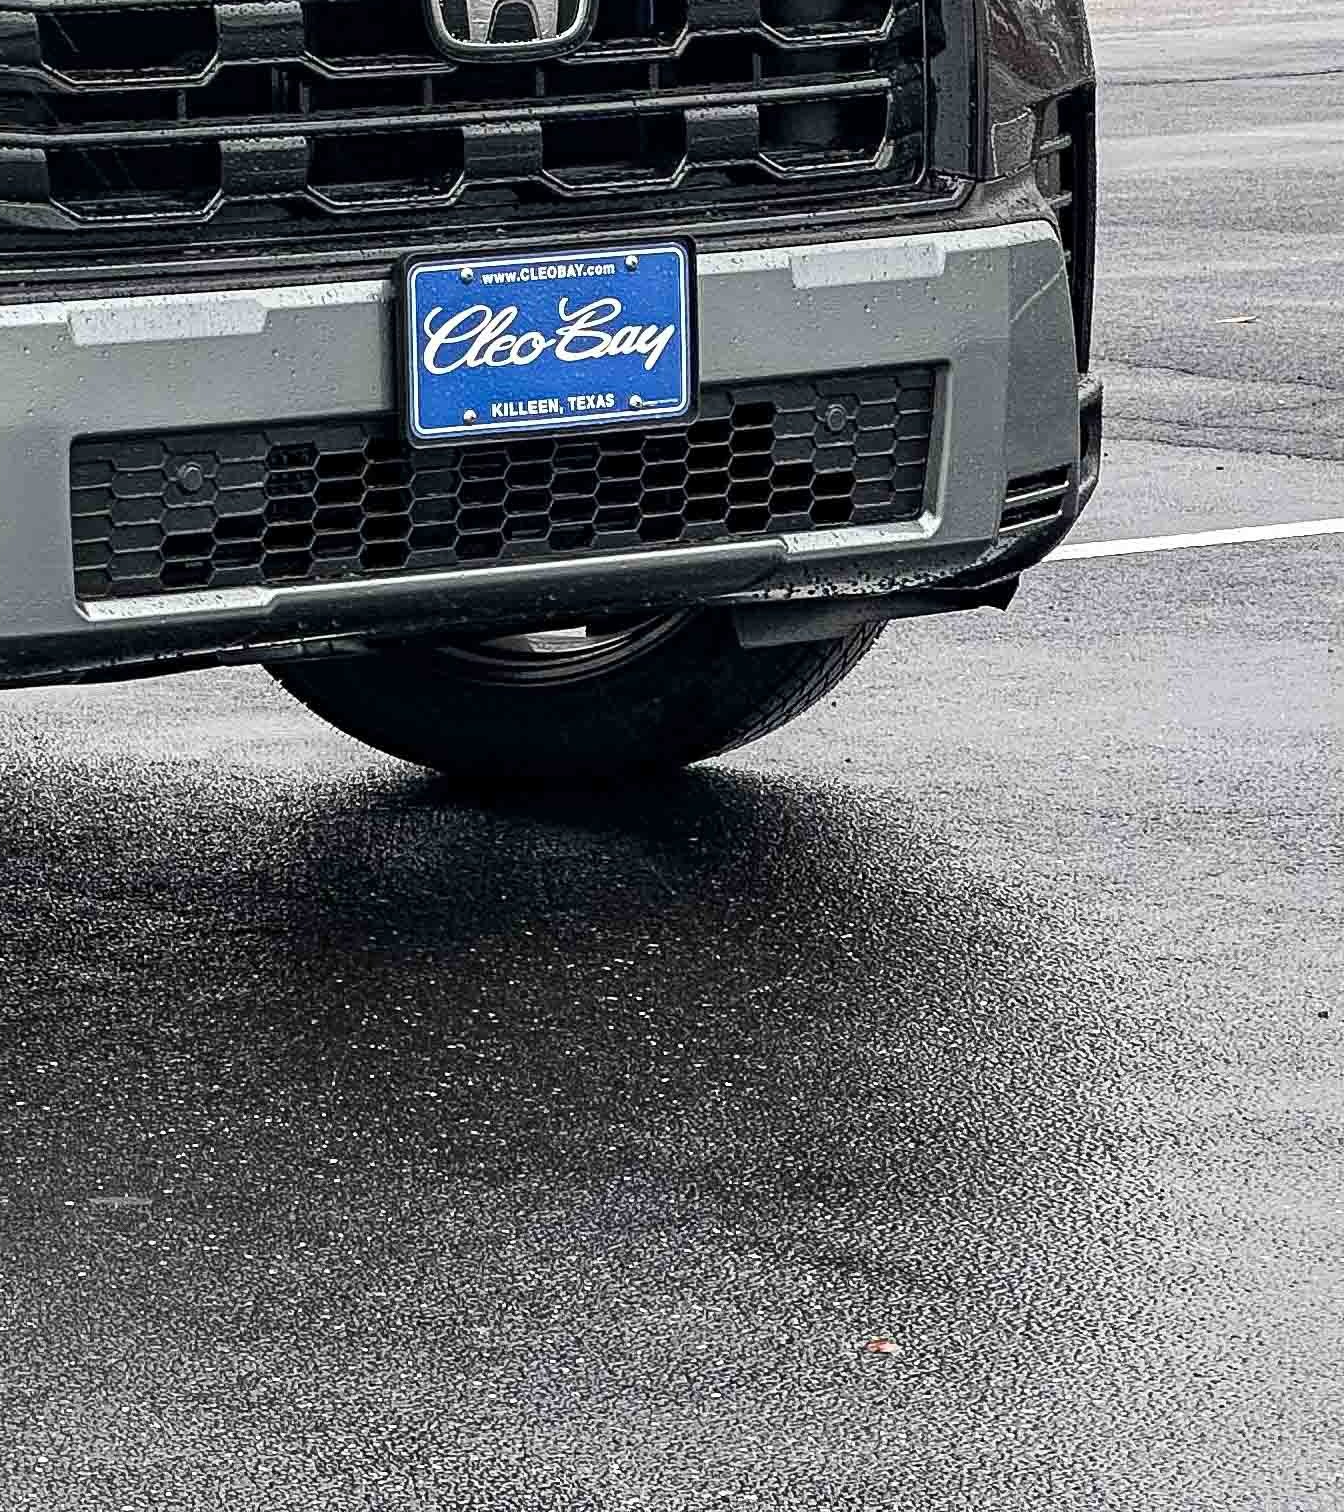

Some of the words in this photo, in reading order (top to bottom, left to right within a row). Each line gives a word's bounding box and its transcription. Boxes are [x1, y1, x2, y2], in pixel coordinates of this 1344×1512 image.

[480, 263, 616, 286] www.CLEOBAY.com
[423, 304, 557, 375] Cleo
[555, 296, 676, 371] Bay
[491, 398, 564, 418] KILLEEN,
[567, 393, 616, 412] TEXAS
